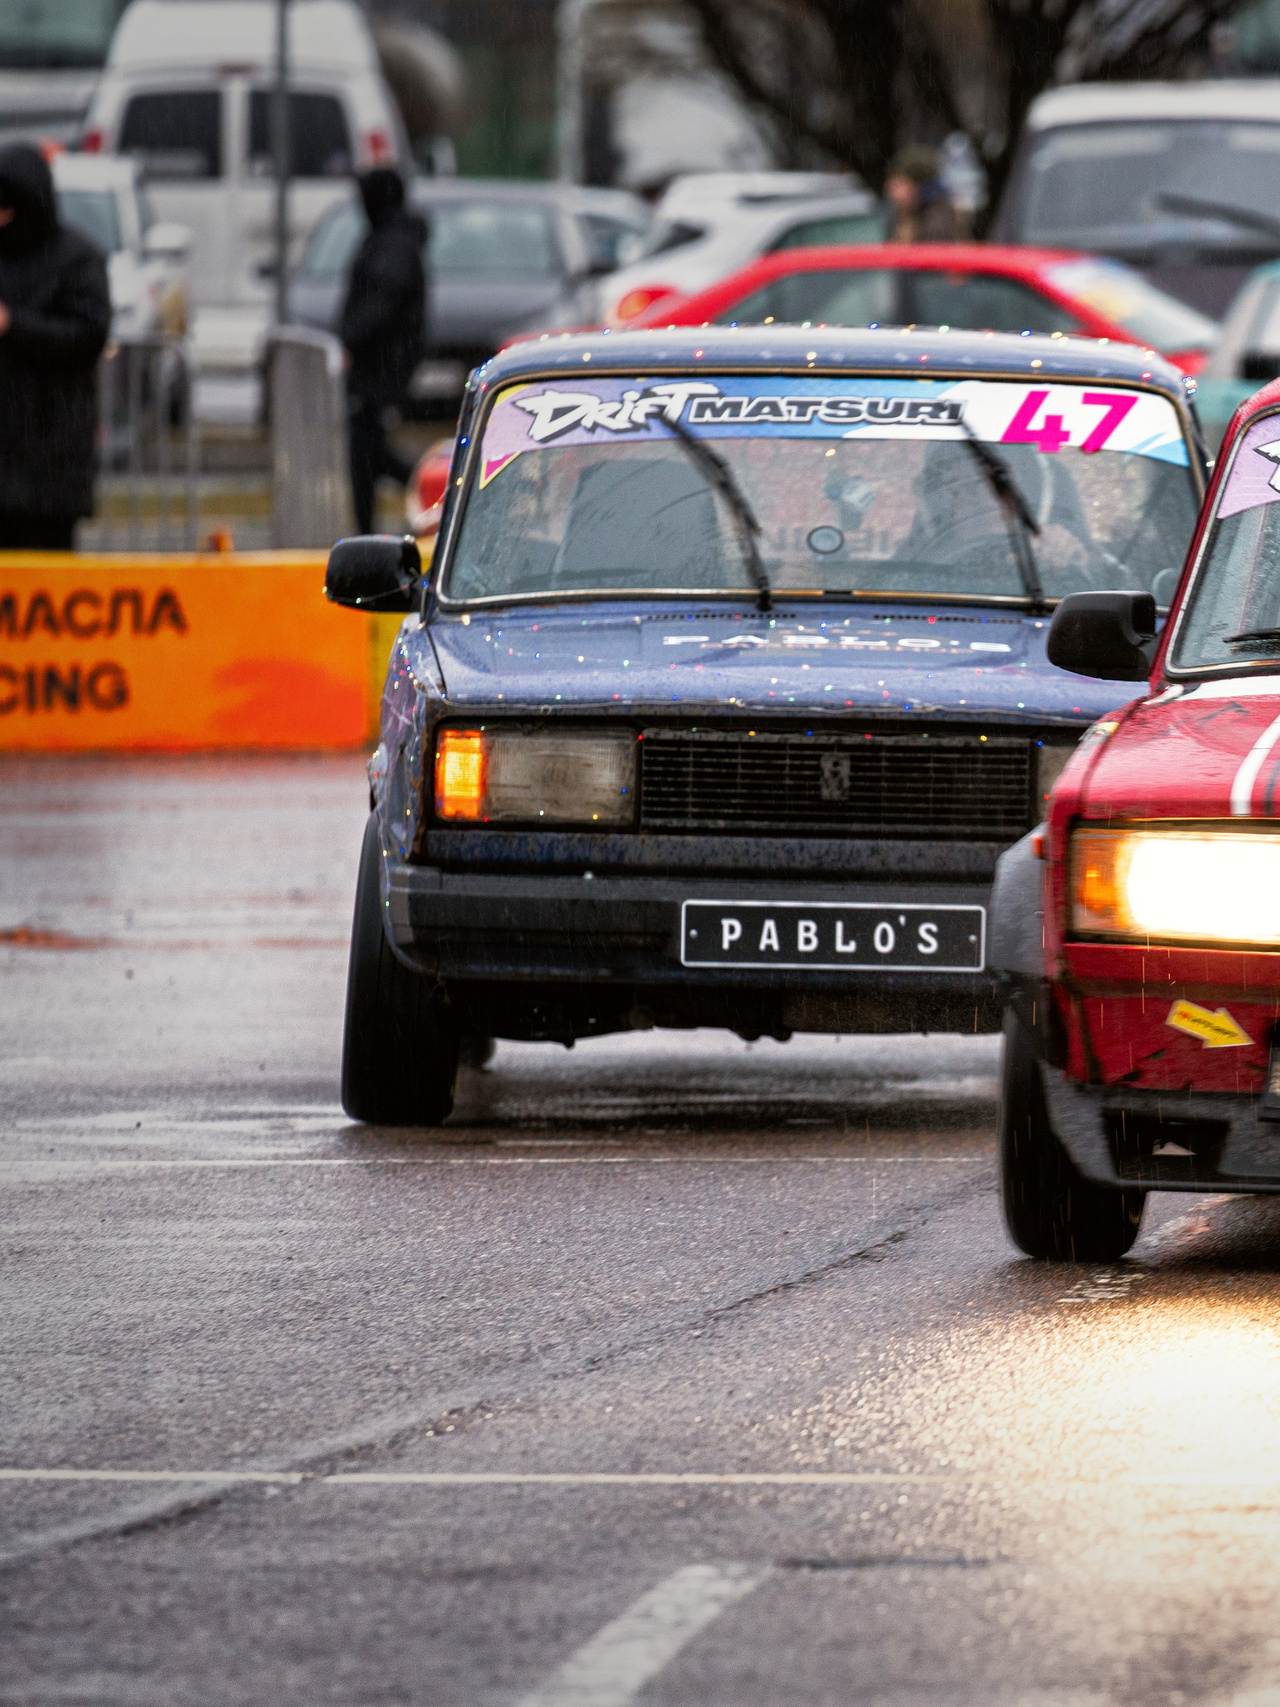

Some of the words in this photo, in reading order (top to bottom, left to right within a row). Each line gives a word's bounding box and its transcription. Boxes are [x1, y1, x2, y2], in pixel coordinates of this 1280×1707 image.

[688, 396, 968, 427] MATSURI
[1000, 390, 1140, 454] 47
[663, 635, 1012, 652] PABLO'S
[721, 915, 939, 954] PABLO'S
